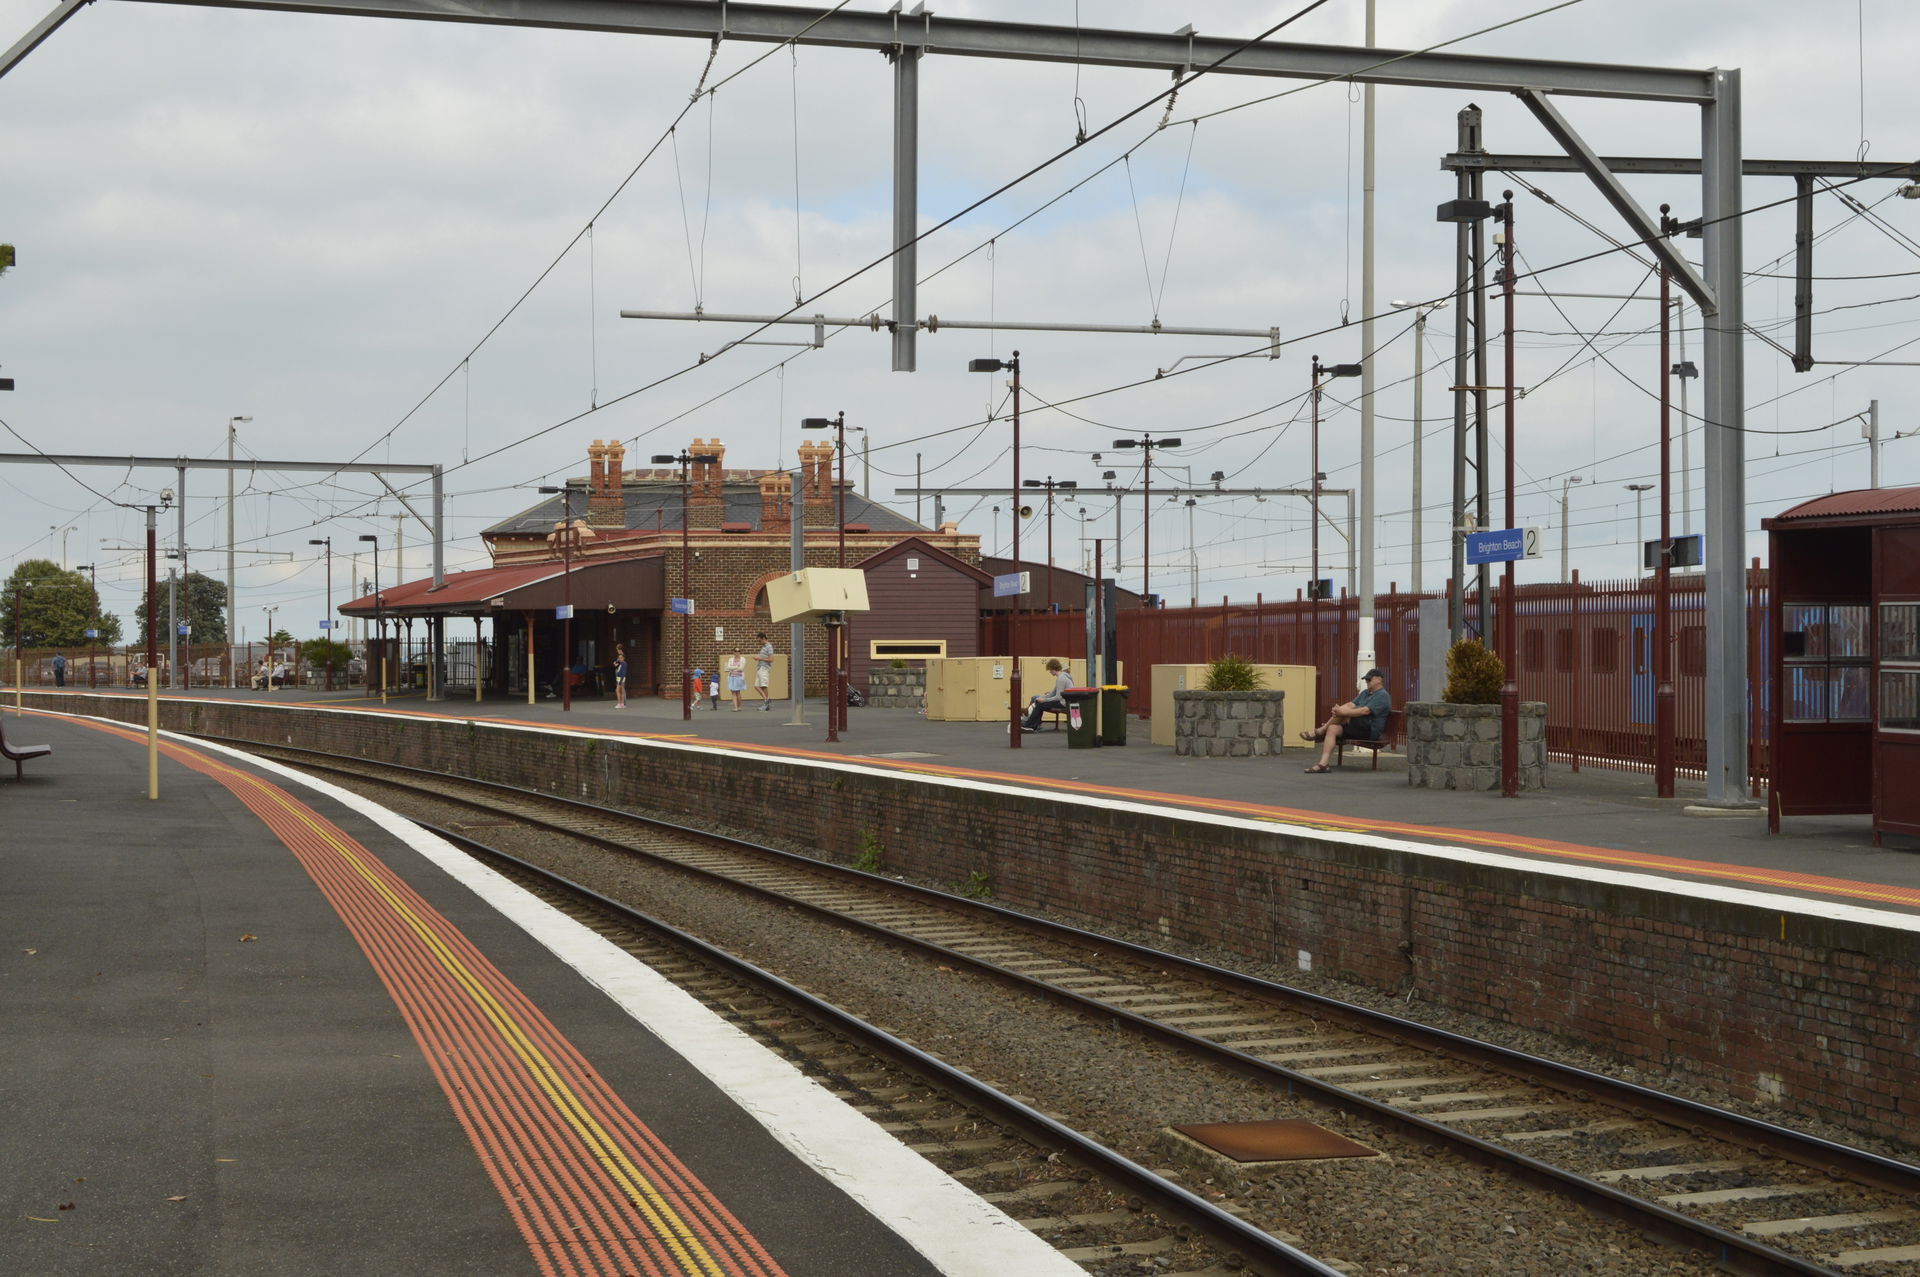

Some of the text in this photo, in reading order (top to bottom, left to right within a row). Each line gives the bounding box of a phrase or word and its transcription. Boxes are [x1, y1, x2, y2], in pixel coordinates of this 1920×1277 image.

[1479, 539, 1522, 554] Brighton Beach
[1527, 530, 1536, 555] 2
